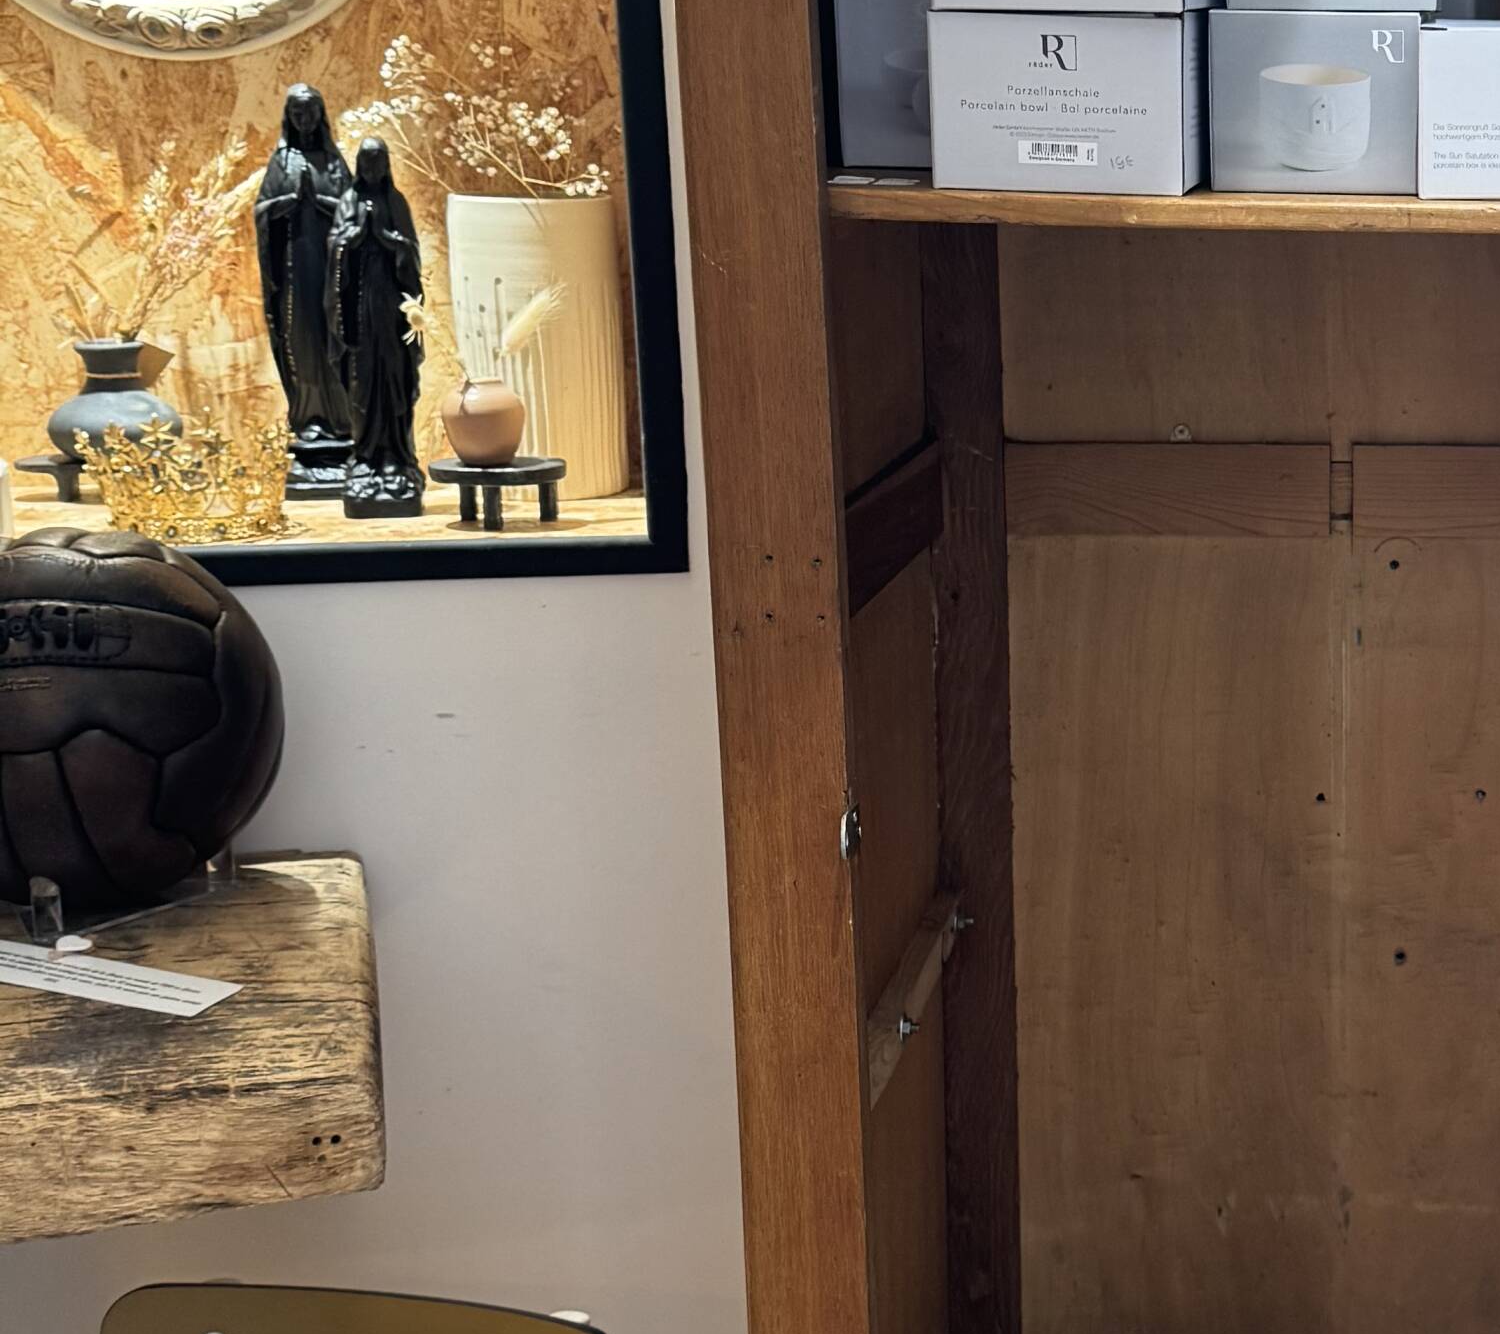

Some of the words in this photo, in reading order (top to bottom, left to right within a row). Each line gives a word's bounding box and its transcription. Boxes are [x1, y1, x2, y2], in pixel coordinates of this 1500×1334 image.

[1041, 34, 1068, 71] R
[1371, 29, 1396, 63] R
[1007, 85, 1101, 99] Porzellanschale
[960, 99, 1016, 112] Porcelain
[1020, 101, 1049, 113] bowl
[1061, 103, 1080, 114] Bol
[1084, 105, 1148, 116] porcelaine
